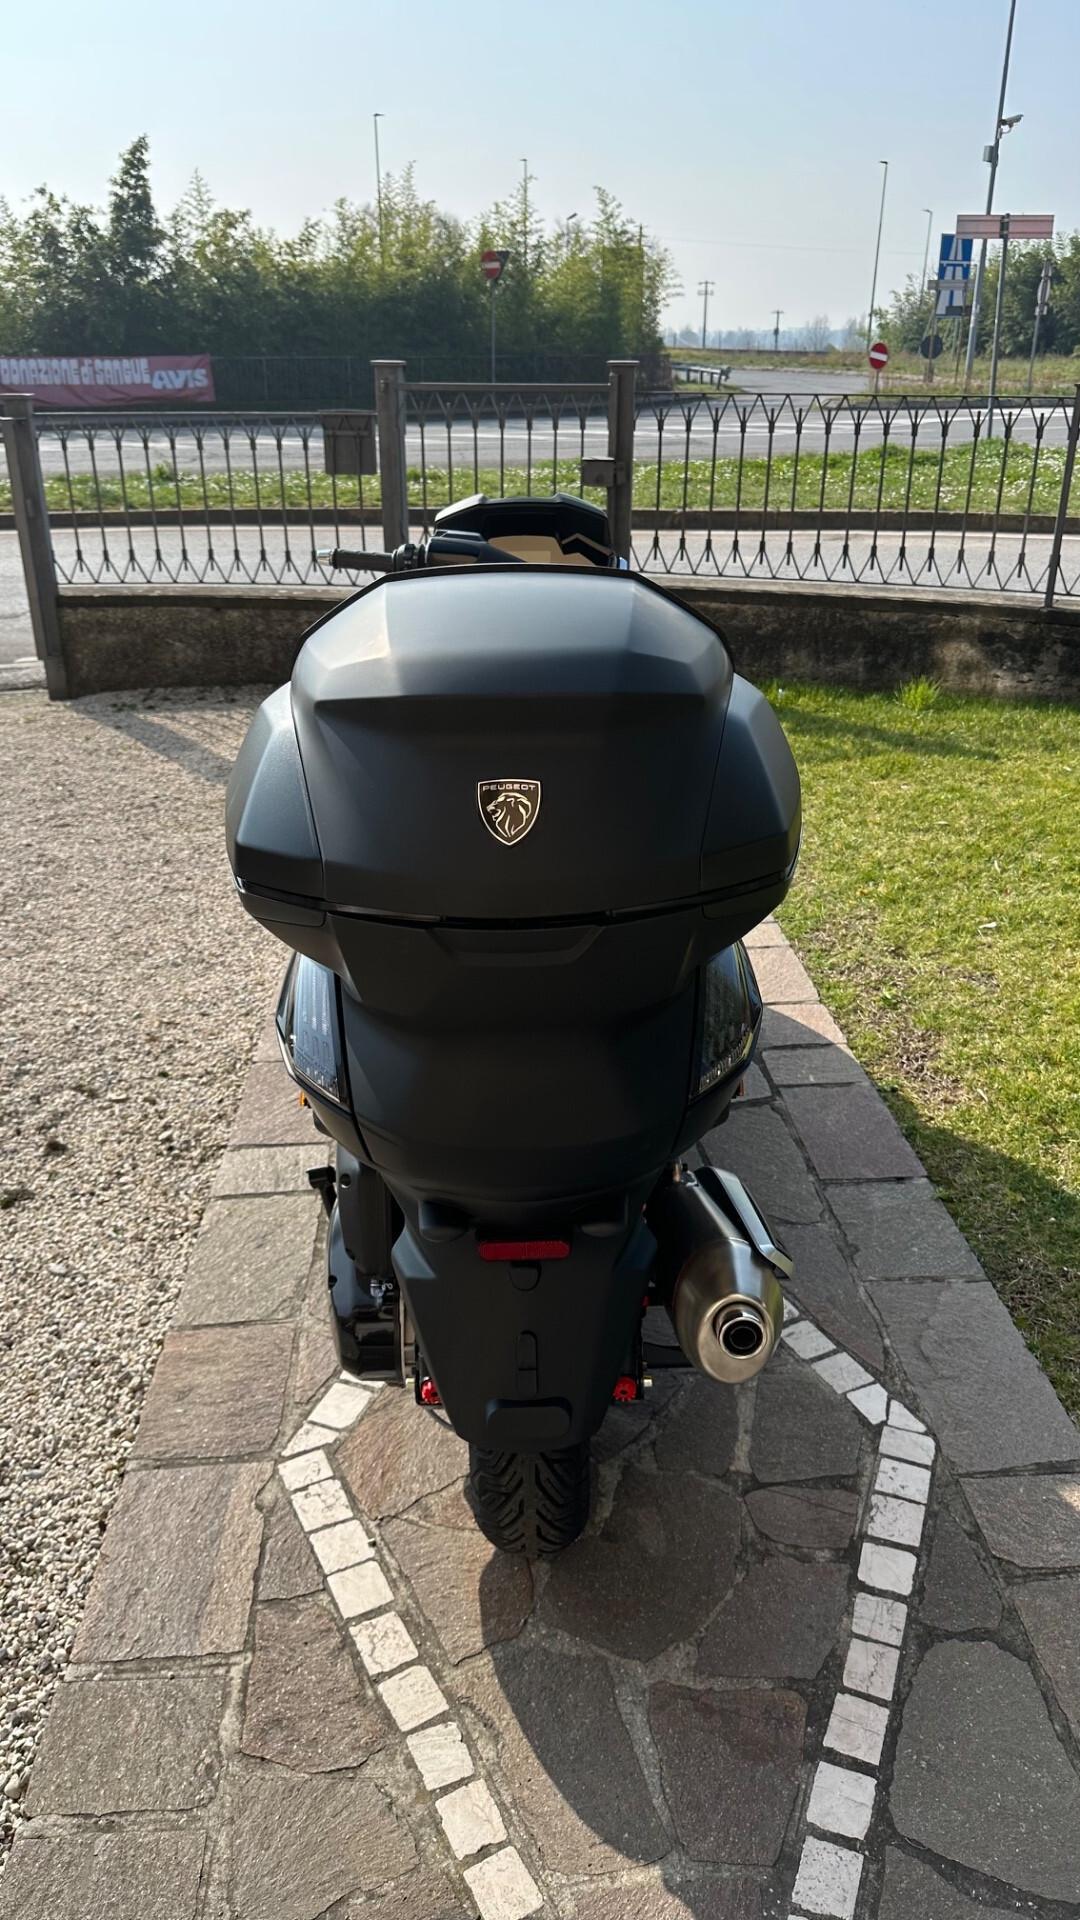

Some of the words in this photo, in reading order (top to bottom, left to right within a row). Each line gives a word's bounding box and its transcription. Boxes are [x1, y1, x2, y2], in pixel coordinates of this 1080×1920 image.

[95, 359, 150, 384] SANGUE
[152, 369, 208, 389] AVIS
[482, 783, 536, 791] PEUGEOT
